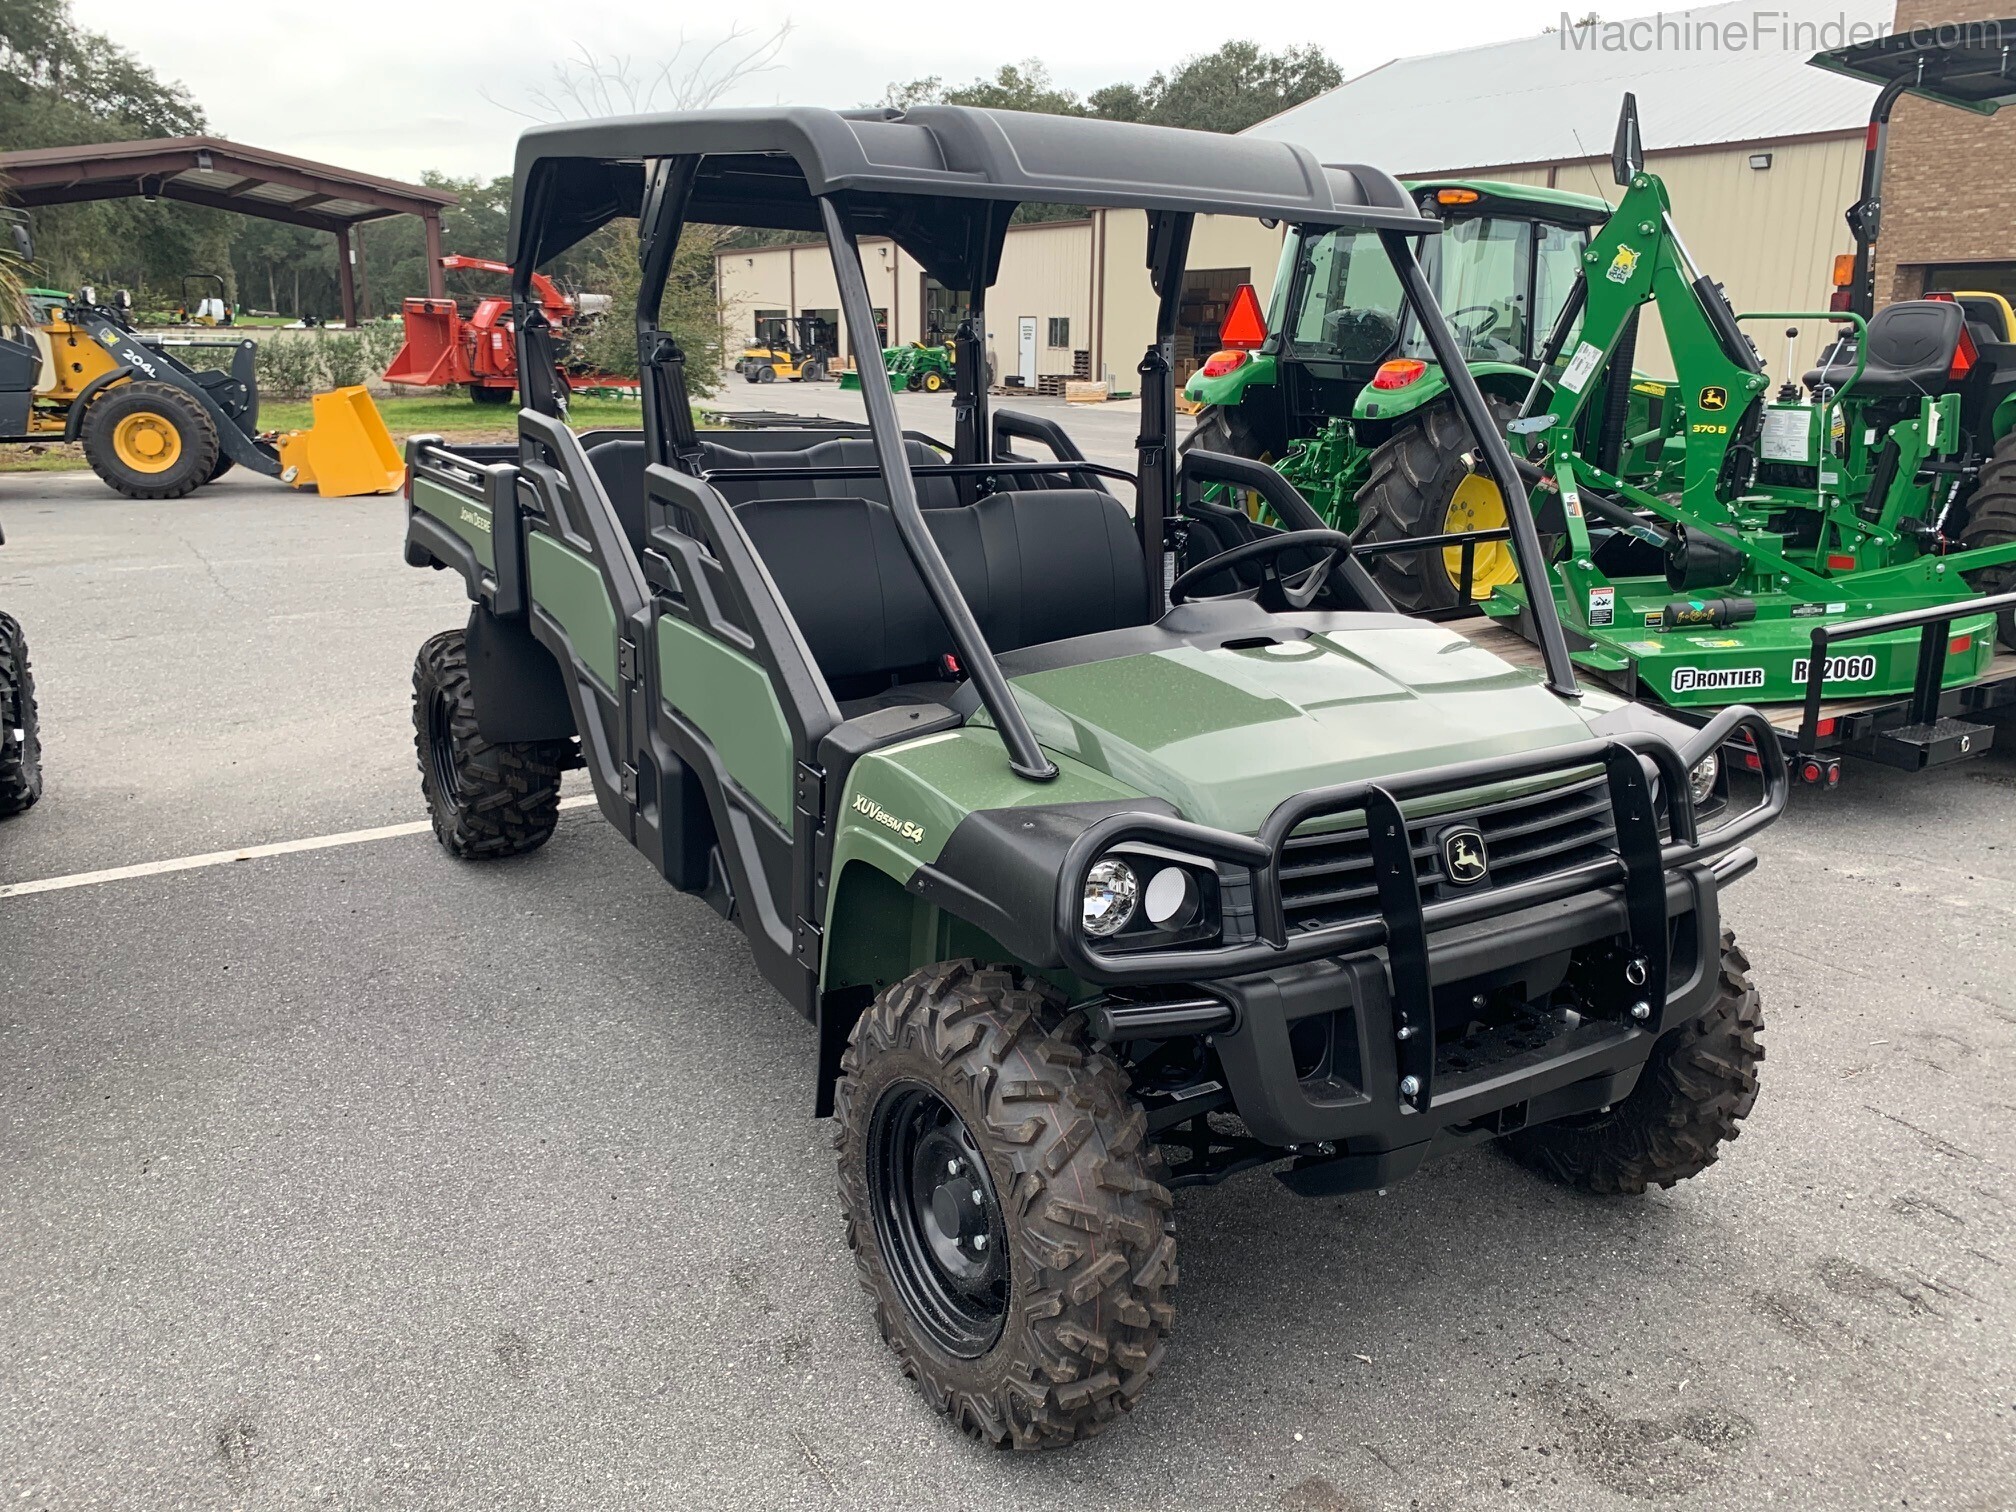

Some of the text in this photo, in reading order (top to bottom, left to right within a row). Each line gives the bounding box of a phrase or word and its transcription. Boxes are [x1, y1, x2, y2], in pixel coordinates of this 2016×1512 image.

[122, 349, 156, 378] 204L
[1692, 424, 1727, 434] 370 B
[473, 512, 491, 533] DEERE
[1674, 669, 1762, 690] FRONTIER
[1794, 657, 1874, 681] R2060
[852, 793, 925, 843] XUV855M S4
